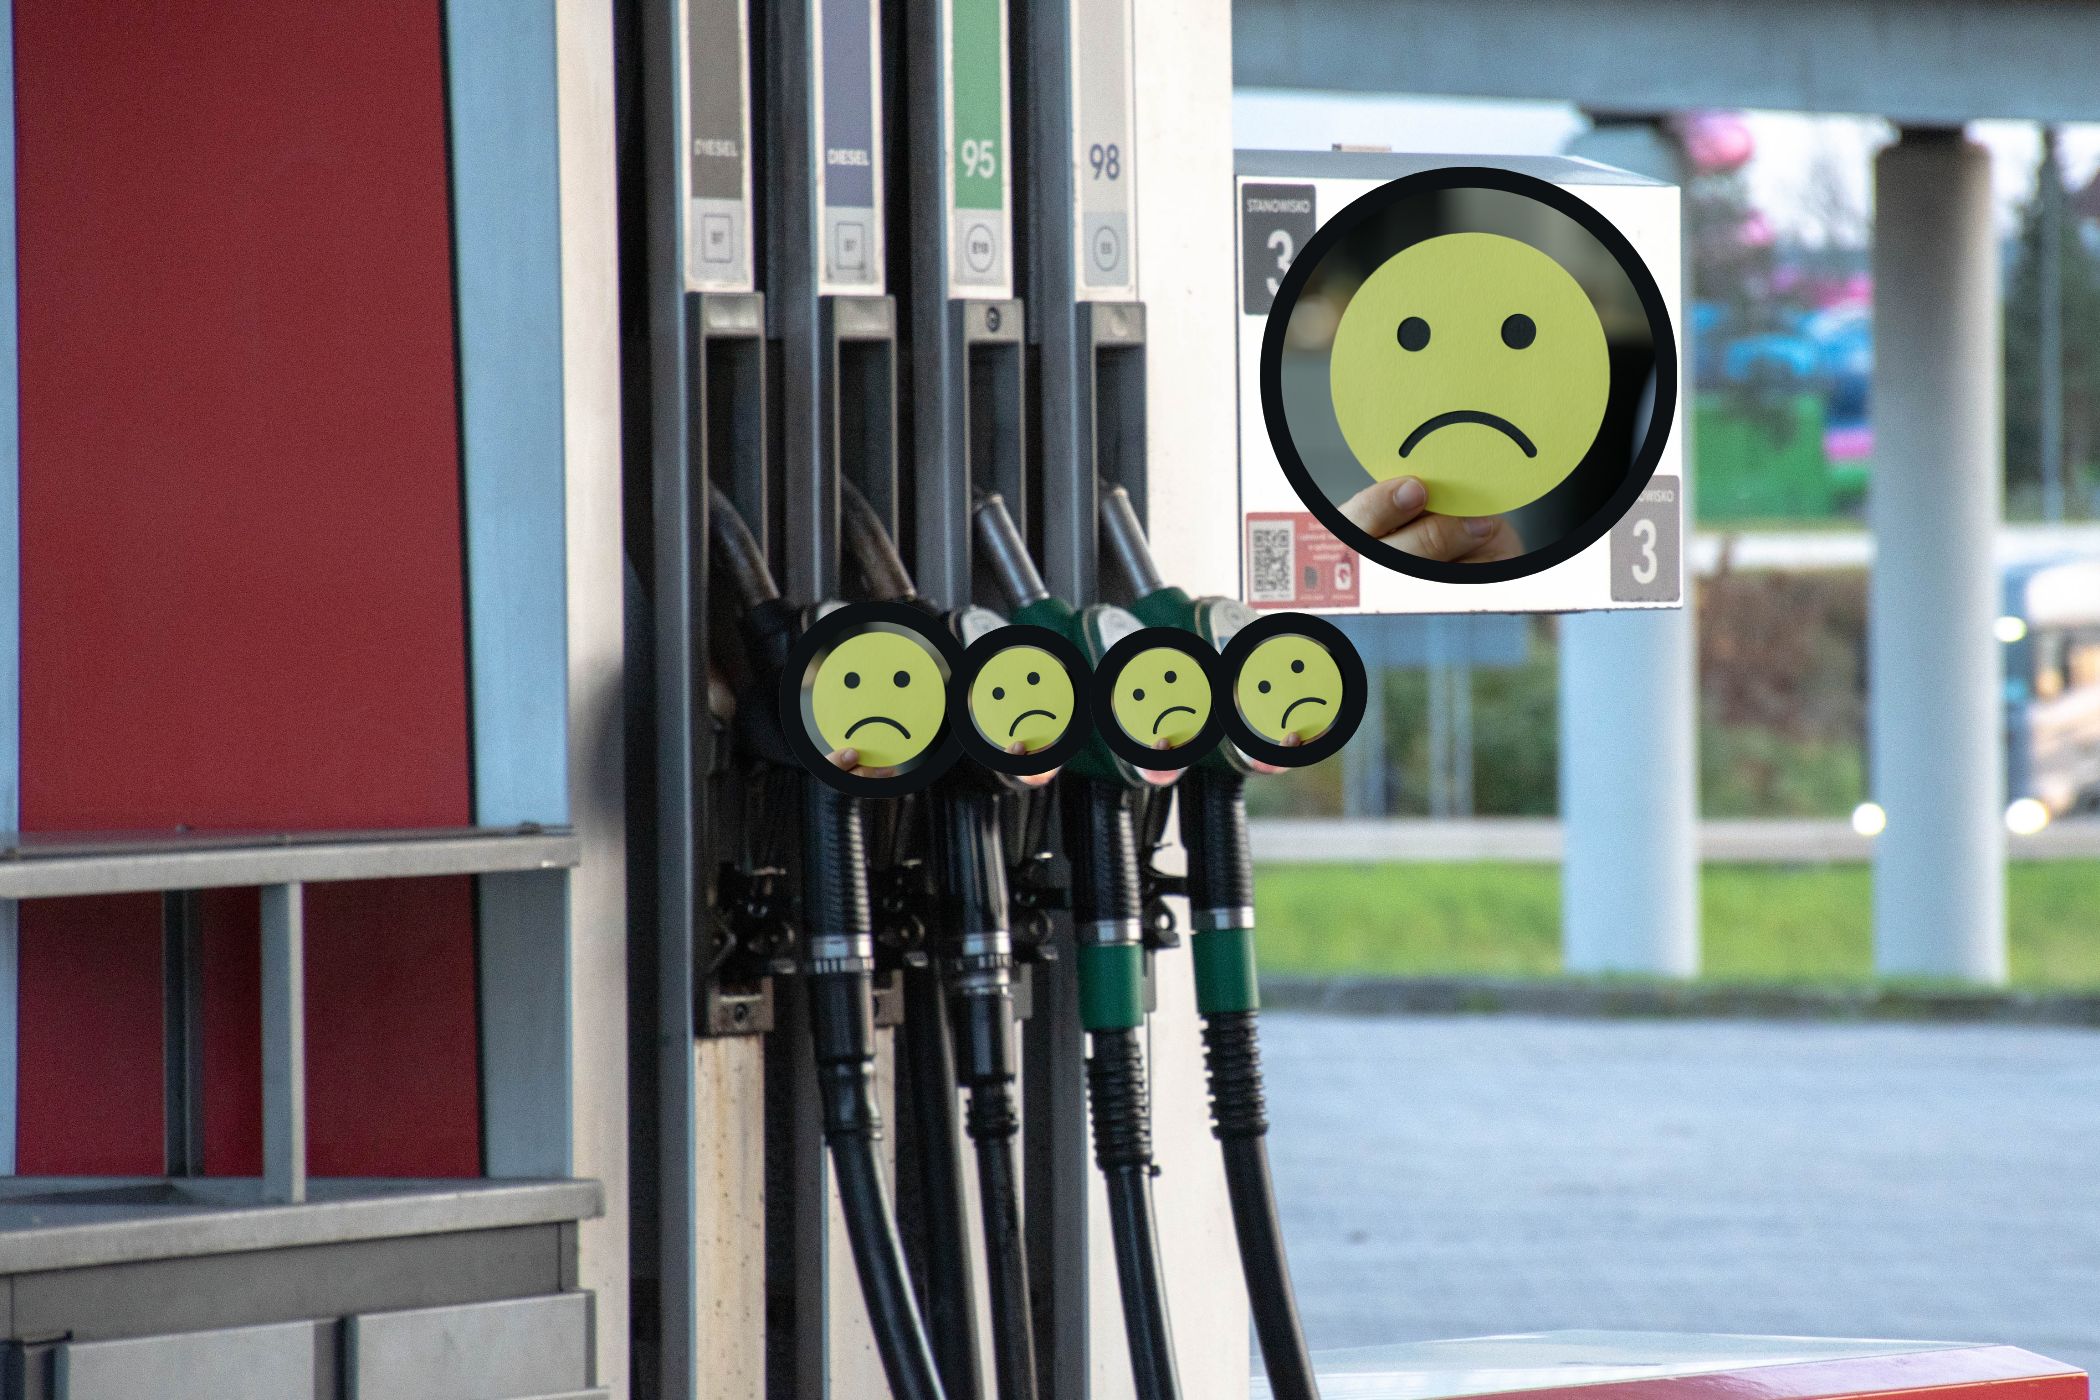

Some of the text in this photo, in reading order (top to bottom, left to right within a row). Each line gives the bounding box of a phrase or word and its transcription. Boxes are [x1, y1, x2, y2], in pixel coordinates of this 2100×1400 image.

[827, 149, 870, 166] DIESEL
[961, 139, 996, 179] 95
[1089, 143, 1120, 181] 98
[1247, 198, 1311, 214] STANOWISKO
[1266, 229, 1294, 298] 3
[1638, 489, 1675, 503] OWISKO
[1632, 518, 1658, 584] 3
